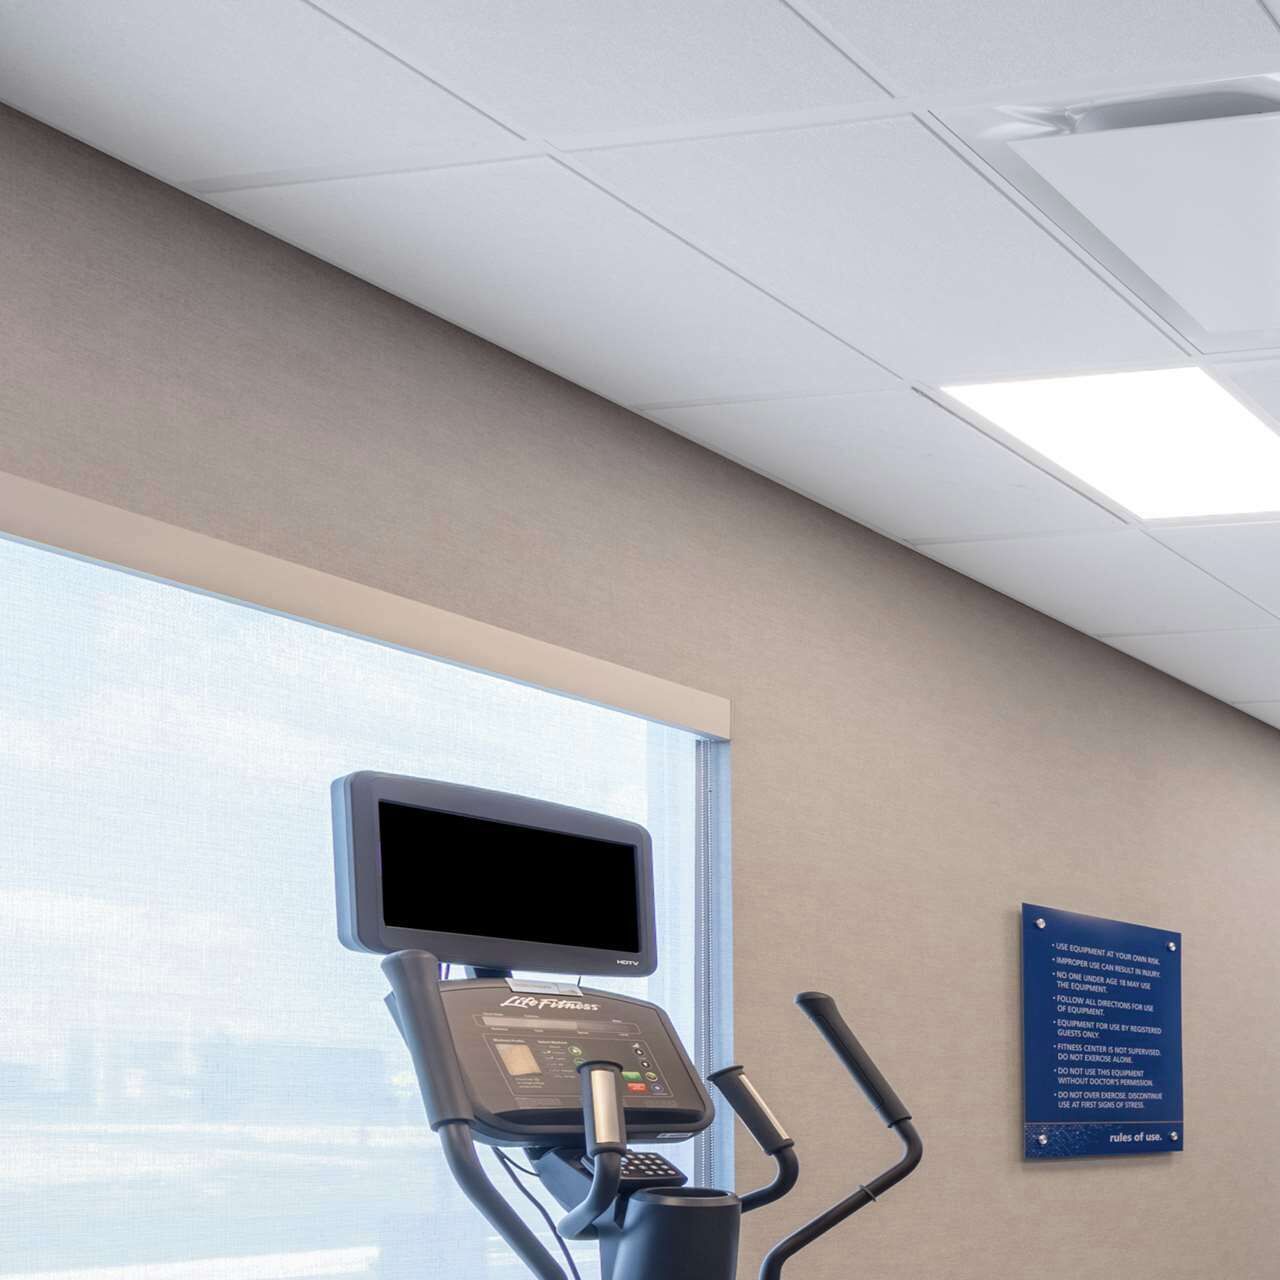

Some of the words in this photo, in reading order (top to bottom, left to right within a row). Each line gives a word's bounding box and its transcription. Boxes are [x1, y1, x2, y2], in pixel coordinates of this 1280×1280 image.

[500, 995, 538, 1008] Life
[538, 998, 600, 1011] Fitness
[1110, 1132, 1132, 1142] rules
[1134, 1132, 1145, 1142] of
[1146, 1133, 1162, 1141] use.
